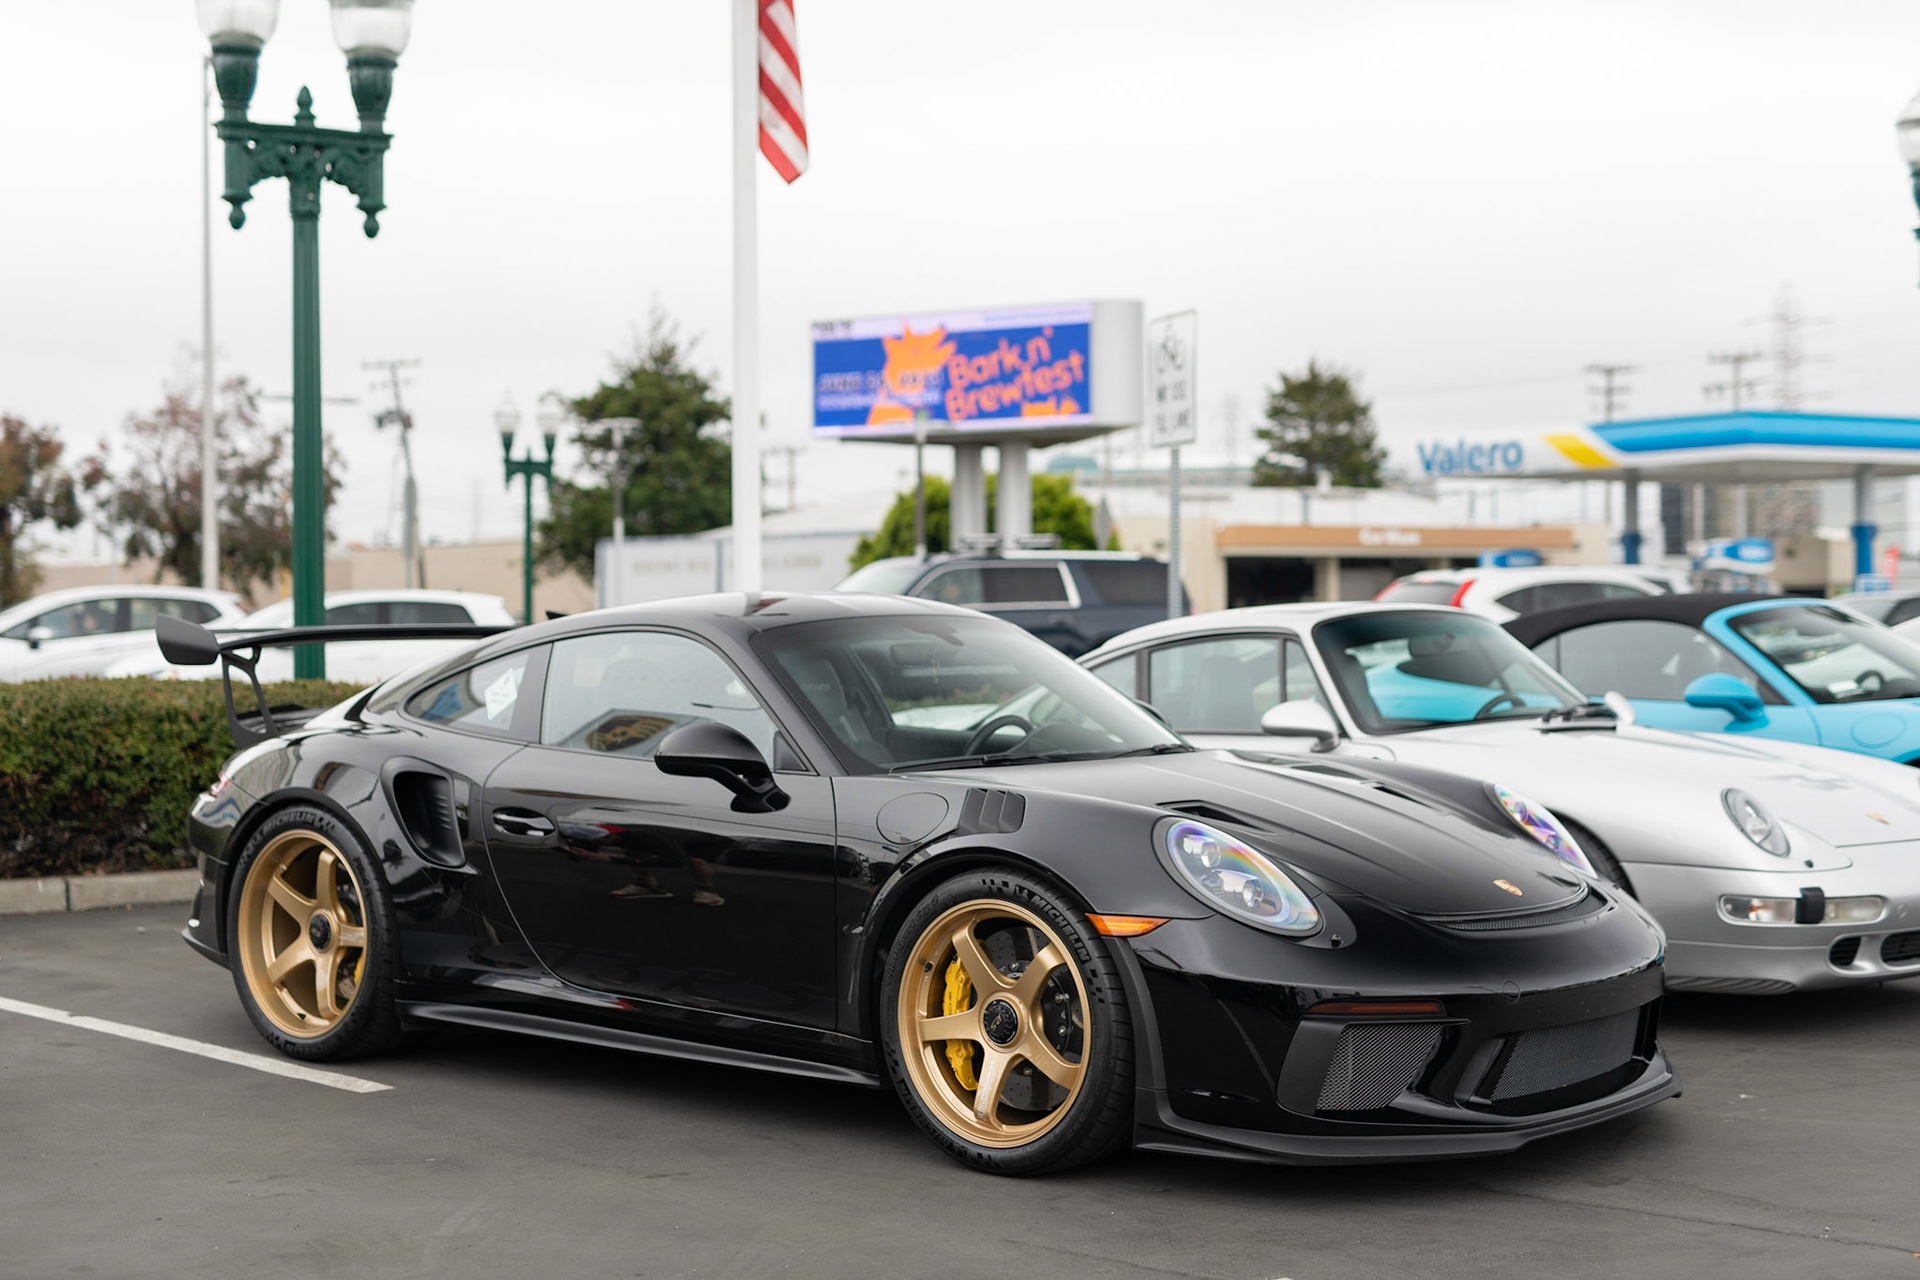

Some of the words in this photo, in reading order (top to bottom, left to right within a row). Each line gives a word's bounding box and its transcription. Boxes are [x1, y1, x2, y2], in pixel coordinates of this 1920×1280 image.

[945, 349, 1085, 421] Brewfest
[948, 337, 1025, 391] Bark
[1417, 438, 1523, 474] Valero
[263, 812, 316, 835] MICHELIN
[1031, 894, 1091, 963] MICHELIN
